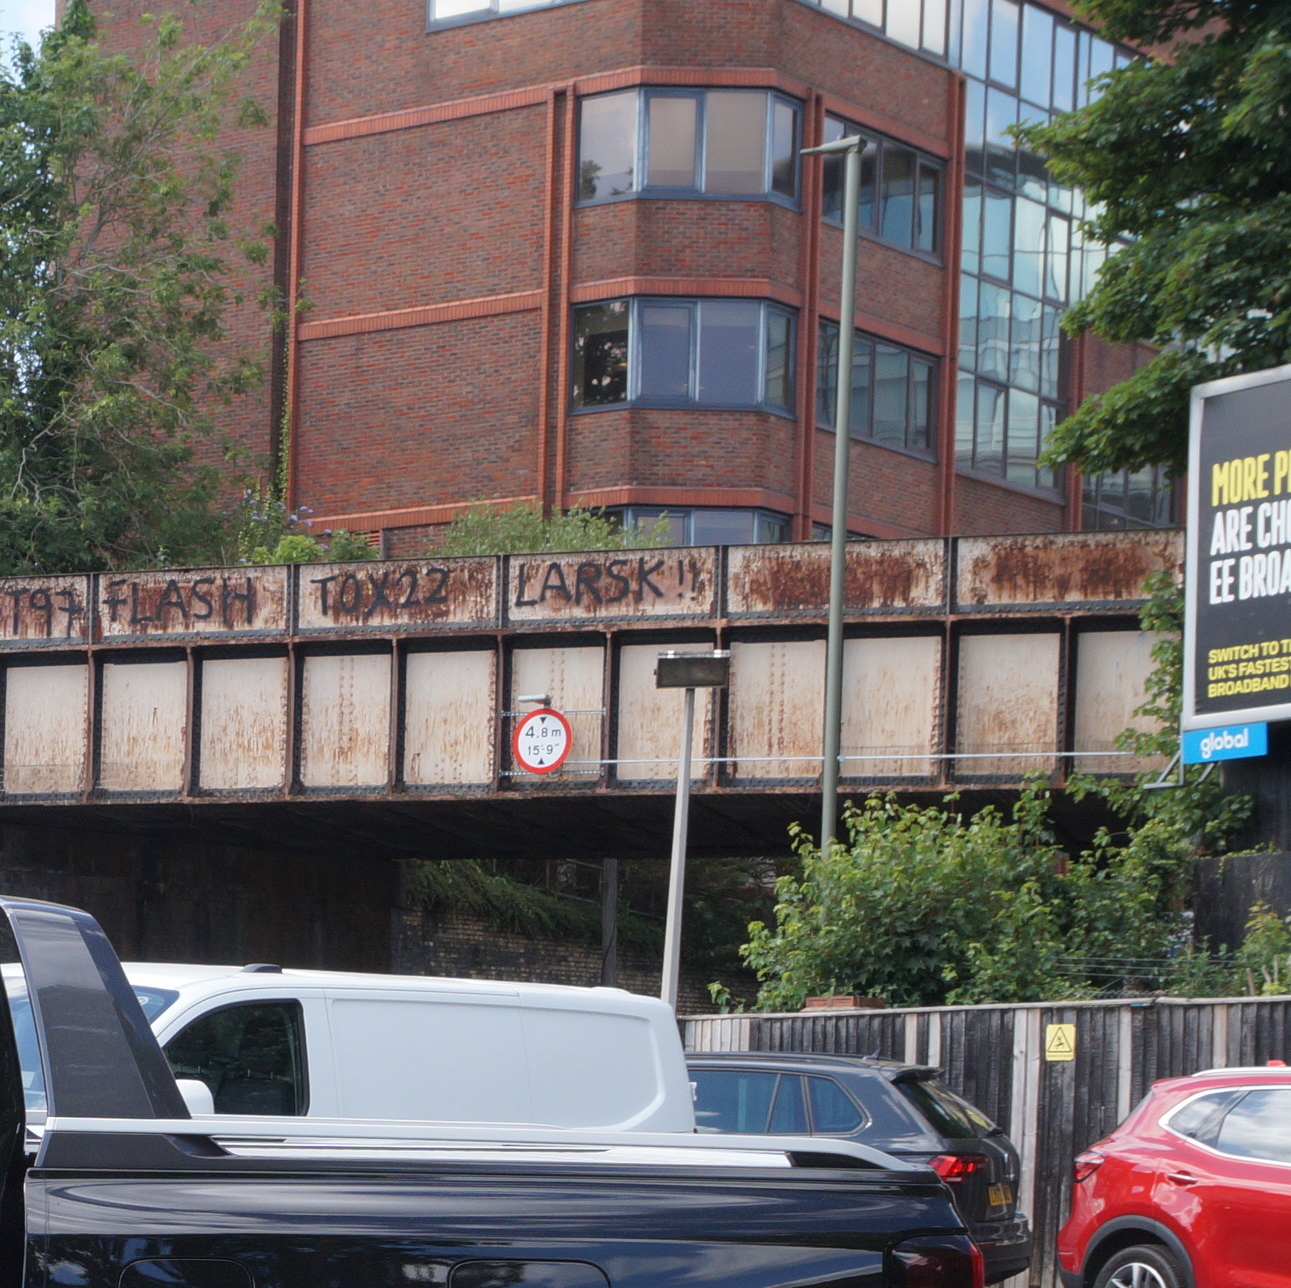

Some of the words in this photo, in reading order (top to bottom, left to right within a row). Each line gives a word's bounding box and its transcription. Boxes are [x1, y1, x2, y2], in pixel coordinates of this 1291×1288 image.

[1212, 453, 1271, 507] MORE
[1274, 449, 1291, 495] P
[1210, 506, 1254, 556] ARE
[310, 566, 451, 616] TOX22
[1209, 558, 1236, 605] EE
[103, 577, 254, 627] FLASH
[1208, 643, 1259, 664] SWITCH
[1261, 640, 1280, 656] TO
[1280, 638, 1291, 653] T
[1208, 663, 1238, 681] UK'S
[1208, 673, 1289, 698] BROADBAND
[525, 725, 548, 739] 4.8
[551, 728, 561, 738] m
[1200, 727, 1249, 759] global
